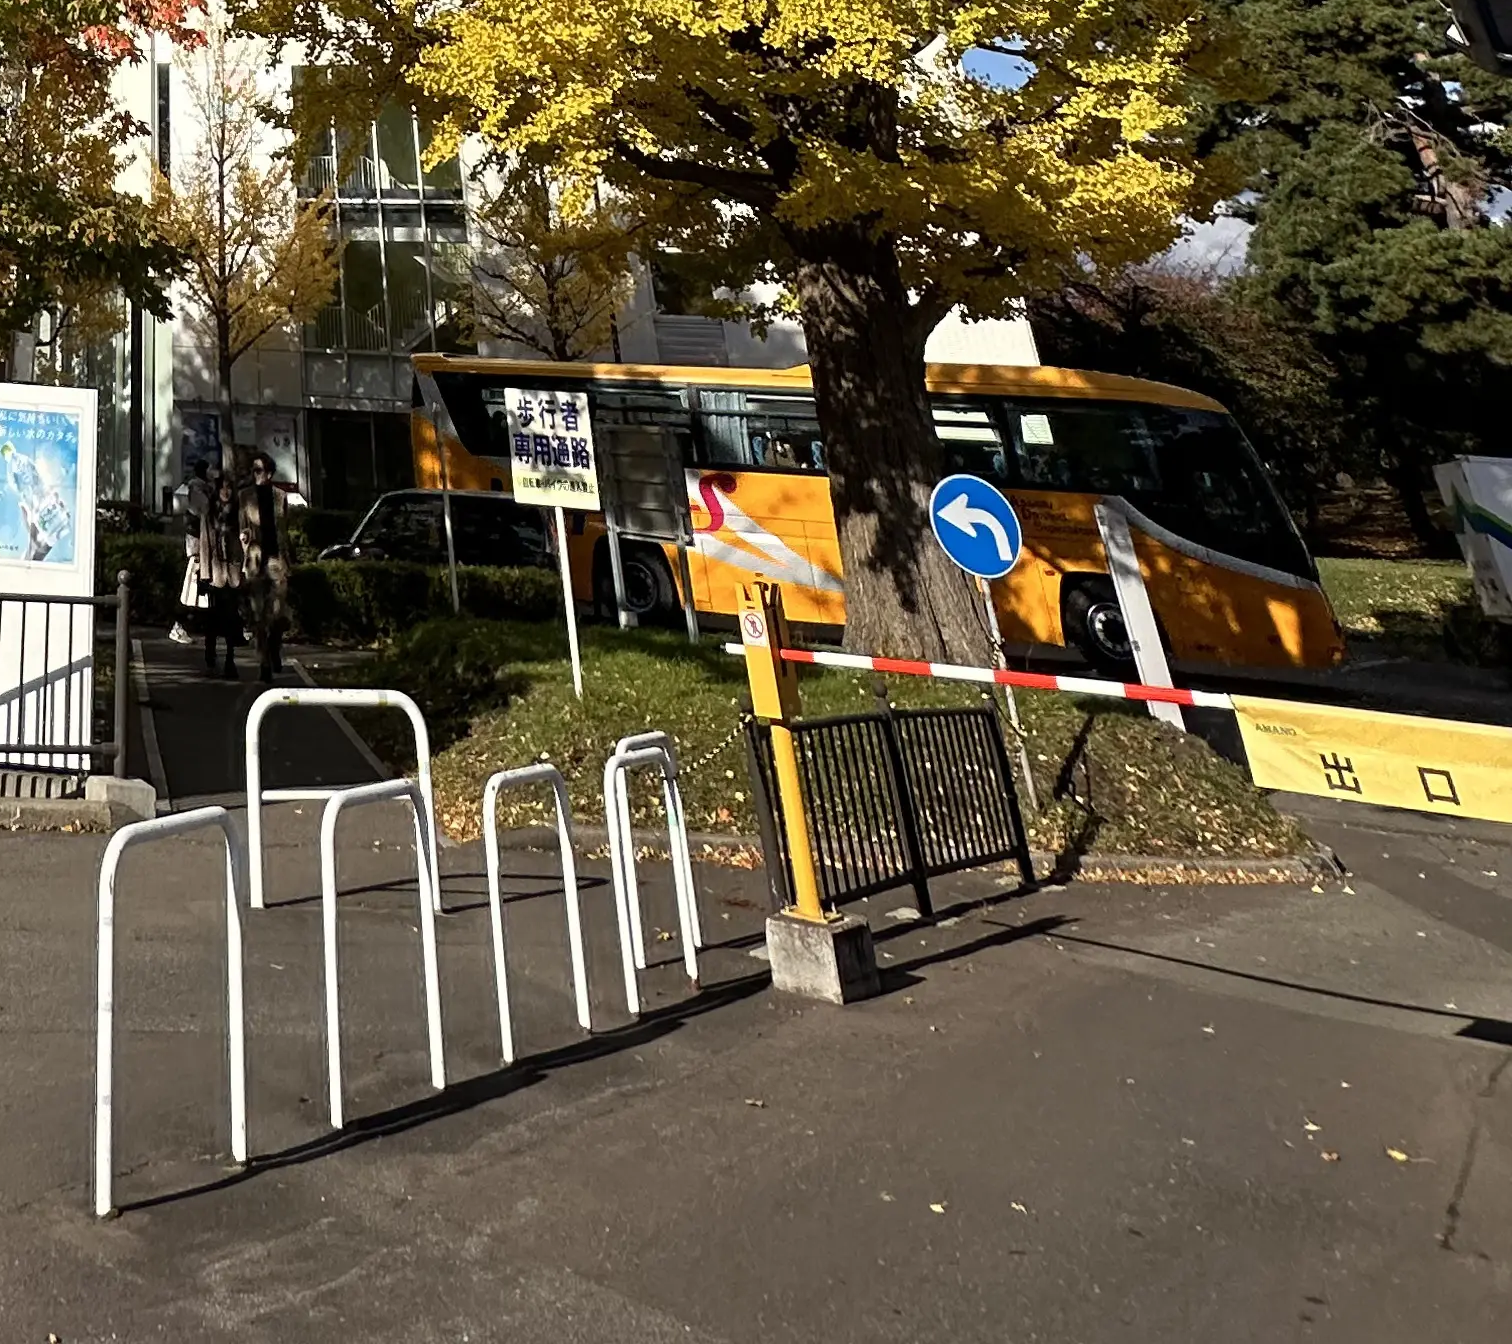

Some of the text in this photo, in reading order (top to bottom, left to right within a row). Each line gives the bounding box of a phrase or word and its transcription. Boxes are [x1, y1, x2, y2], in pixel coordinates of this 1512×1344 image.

[516, 396, 579, 431] 歩行者
[513, 431, 590, 469] 専用通路
[1255, 722, 1298, 737] AMANO
[1319, 752, 1461, 806] 出口
